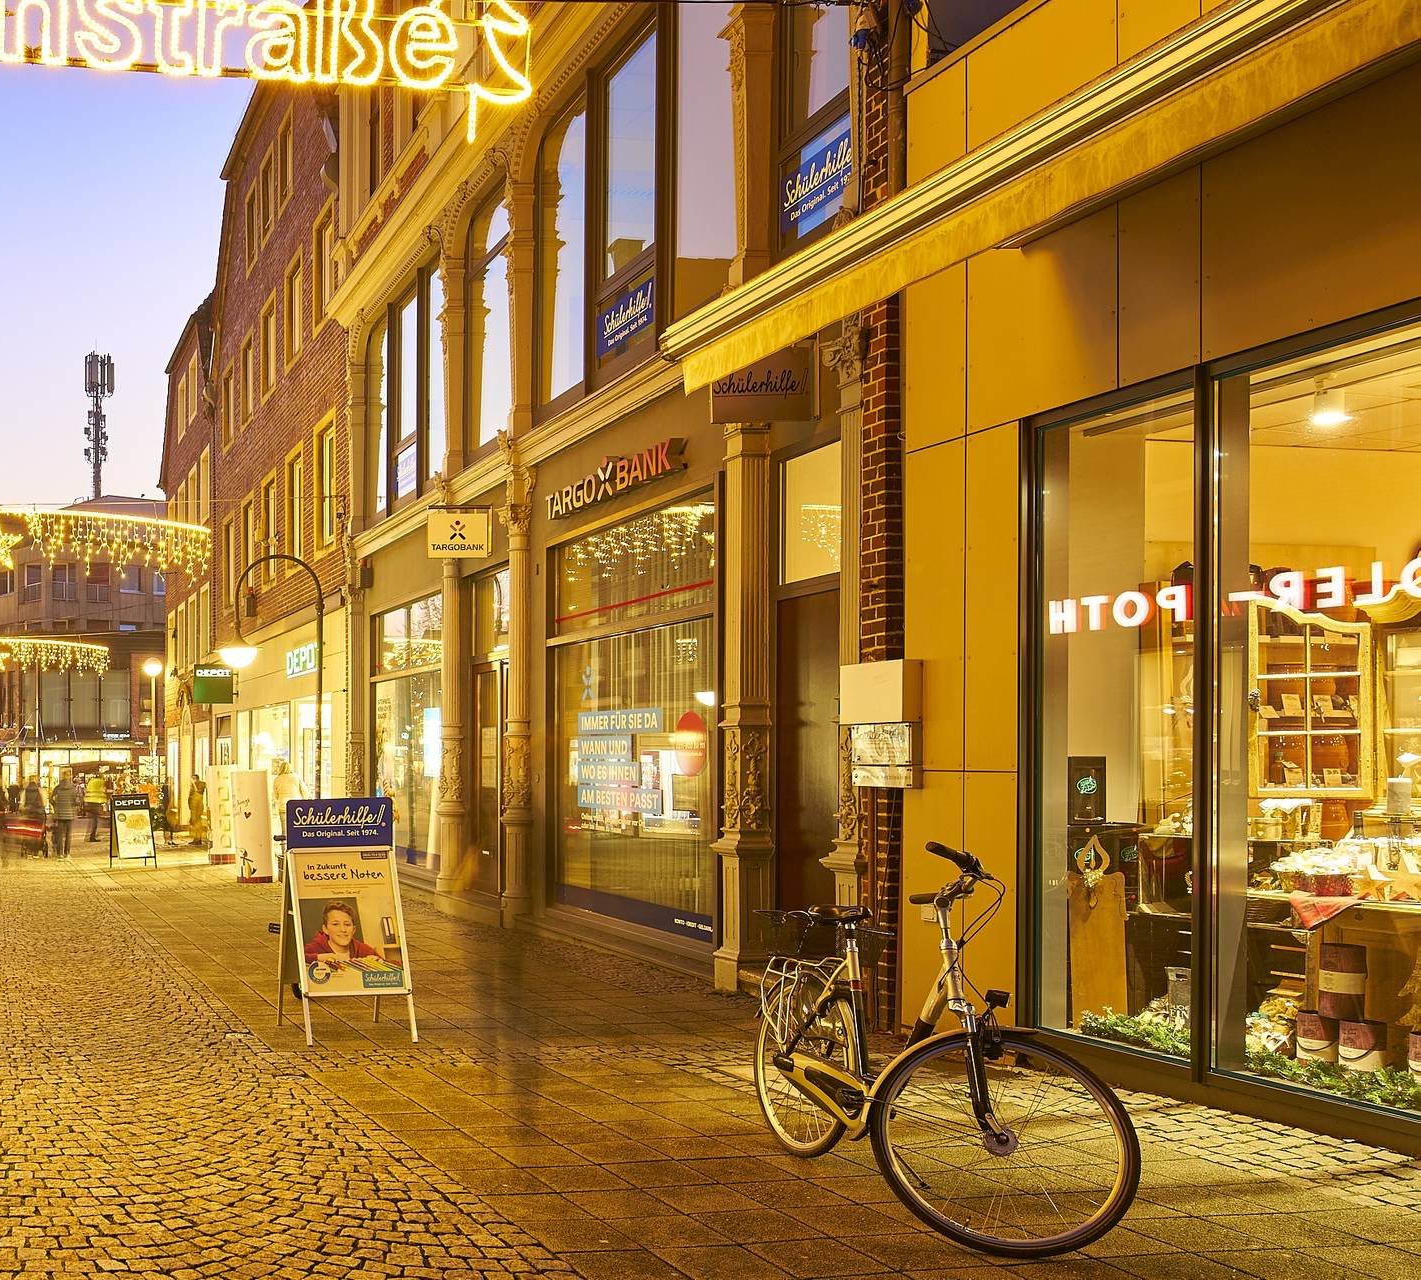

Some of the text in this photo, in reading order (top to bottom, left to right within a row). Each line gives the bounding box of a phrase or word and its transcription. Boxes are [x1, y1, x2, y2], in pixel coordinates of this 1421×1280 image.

[790, 210, 801, 221] Das
[801, 190, 827, 212] Original.
[827, 182, 839, 196] Seit
[616, 438, 672, 491] BANK
[431, 543, 484, 551] TARGOBANK
[581, 711, 658, 731] IMMER FÜR SIE DA
[581, 740, 628, 755] WANN UND
[581, 764, 636, 782] WO ES IHNEN
[114, 798, 147, 807] DEPOT
[581, 789, 659, 810] AM BESTEN PASST
[302, 830, 315, 838] Das
[316, 830, 345, 838] Original.
[346, 829, 360, 837] Seit
[303, 868, 385, 881] bessere Noten
[316, 863, 347, 871] Zukunft
